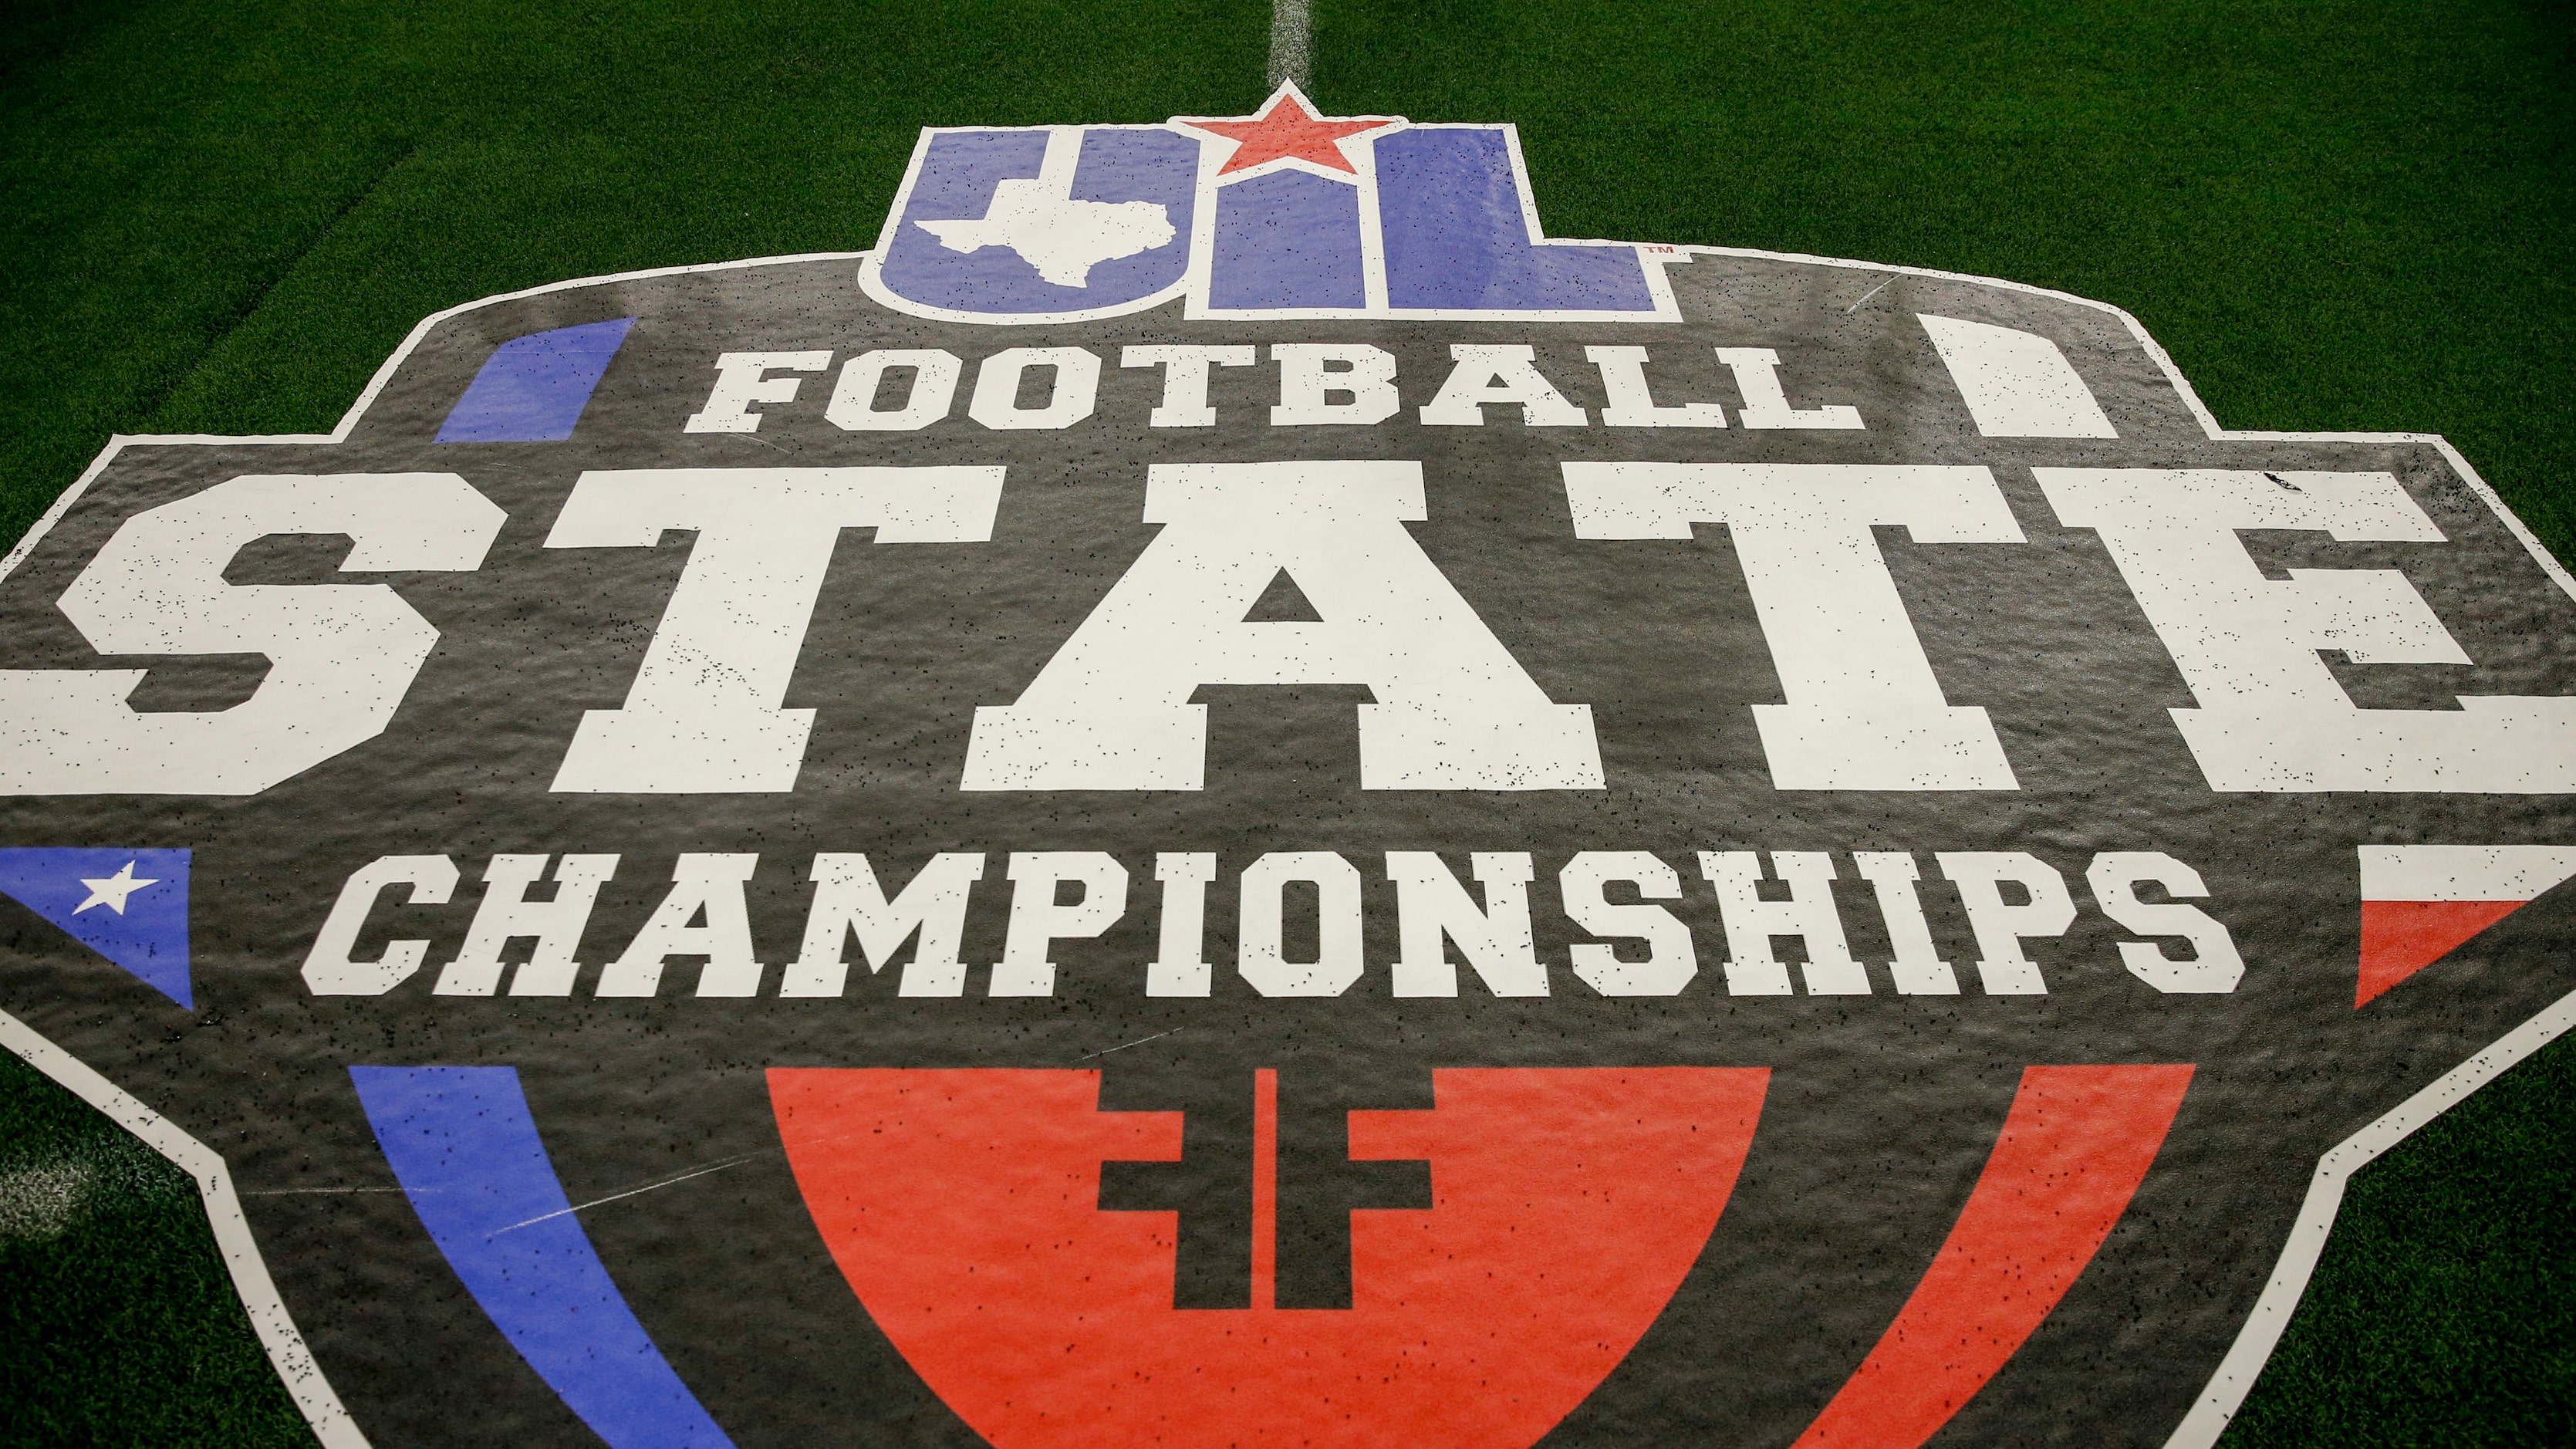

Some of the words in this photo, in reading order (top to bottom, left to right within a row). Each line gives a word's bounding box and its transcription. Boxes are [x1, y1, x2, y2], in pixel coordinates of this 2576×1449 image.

[683, 343, 1866, 434] FOOTBALL
[0, 460, 2576, 795] STATE
[301, 850, 2246, 999] CHAMPIONSHIPS
